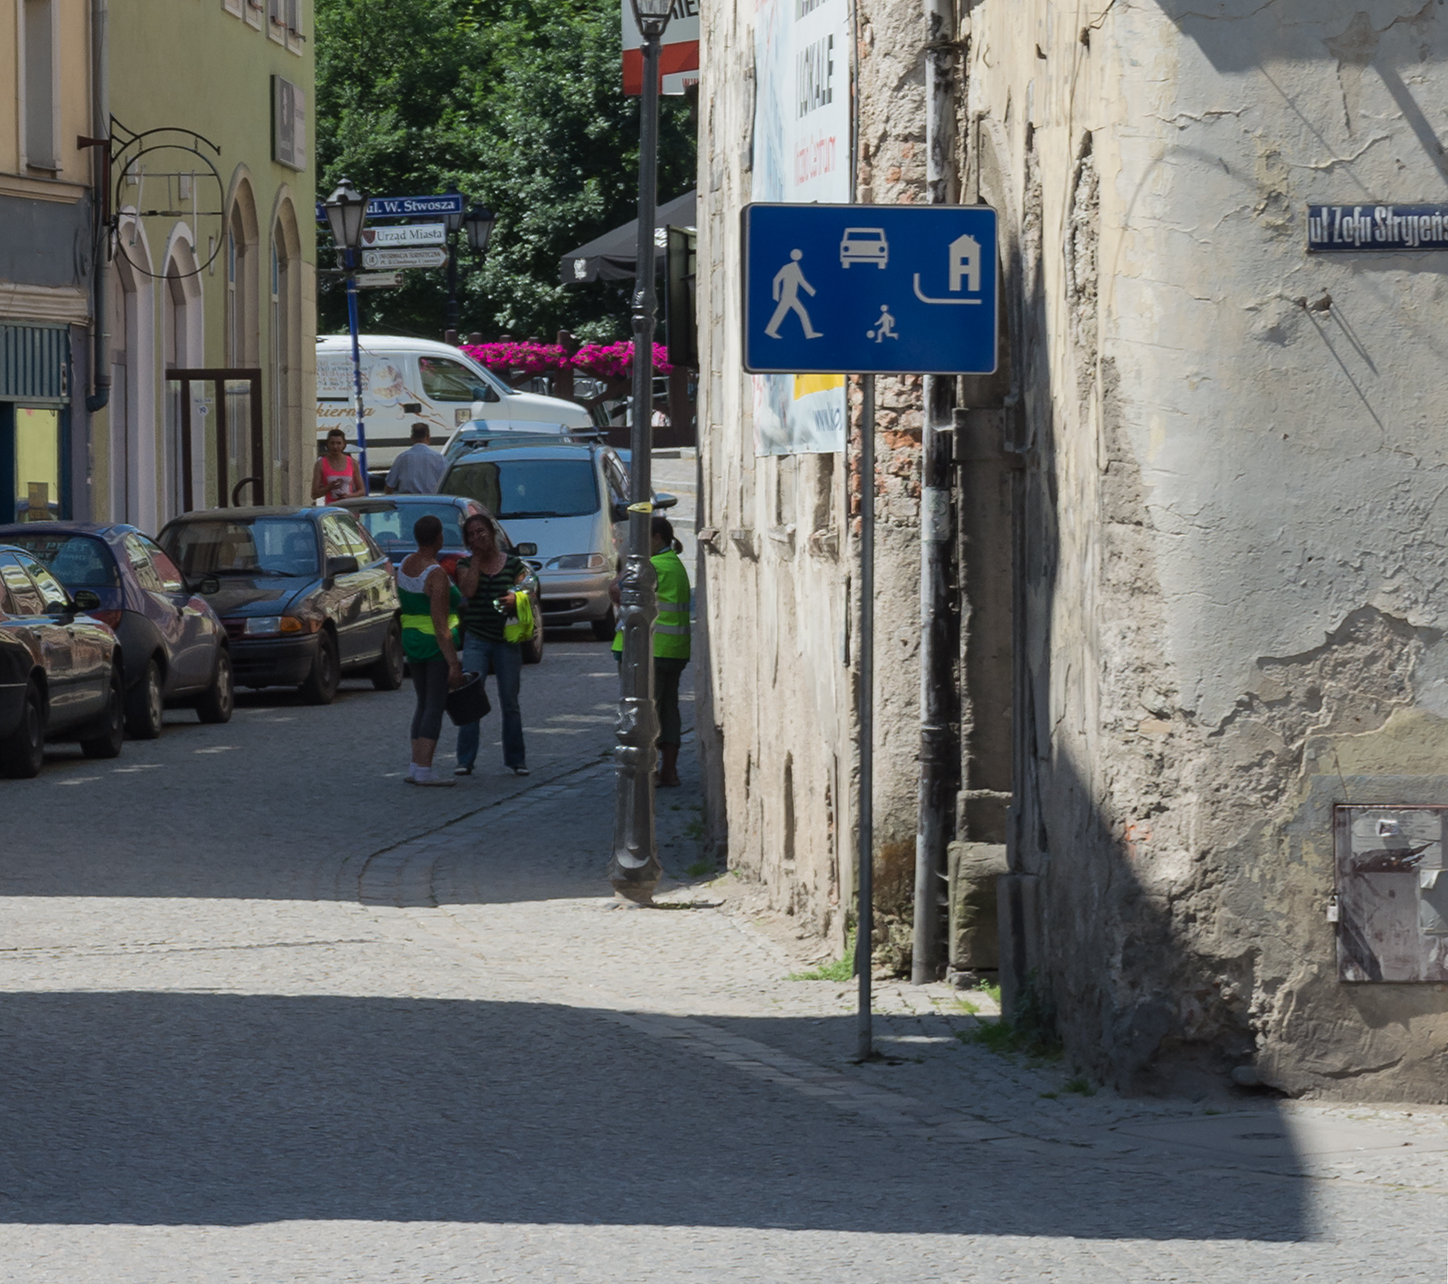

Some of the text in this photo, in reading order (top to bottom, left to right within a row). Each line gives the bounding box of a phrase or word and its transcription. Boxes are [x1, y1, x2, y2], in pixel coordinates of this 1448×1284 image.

[384, 201, 402, 213] W.
[404, 199, 455, 212] Stwosza
[409, 228, 443, 240] Miasta
[316, 402, 376, 418] kierna
